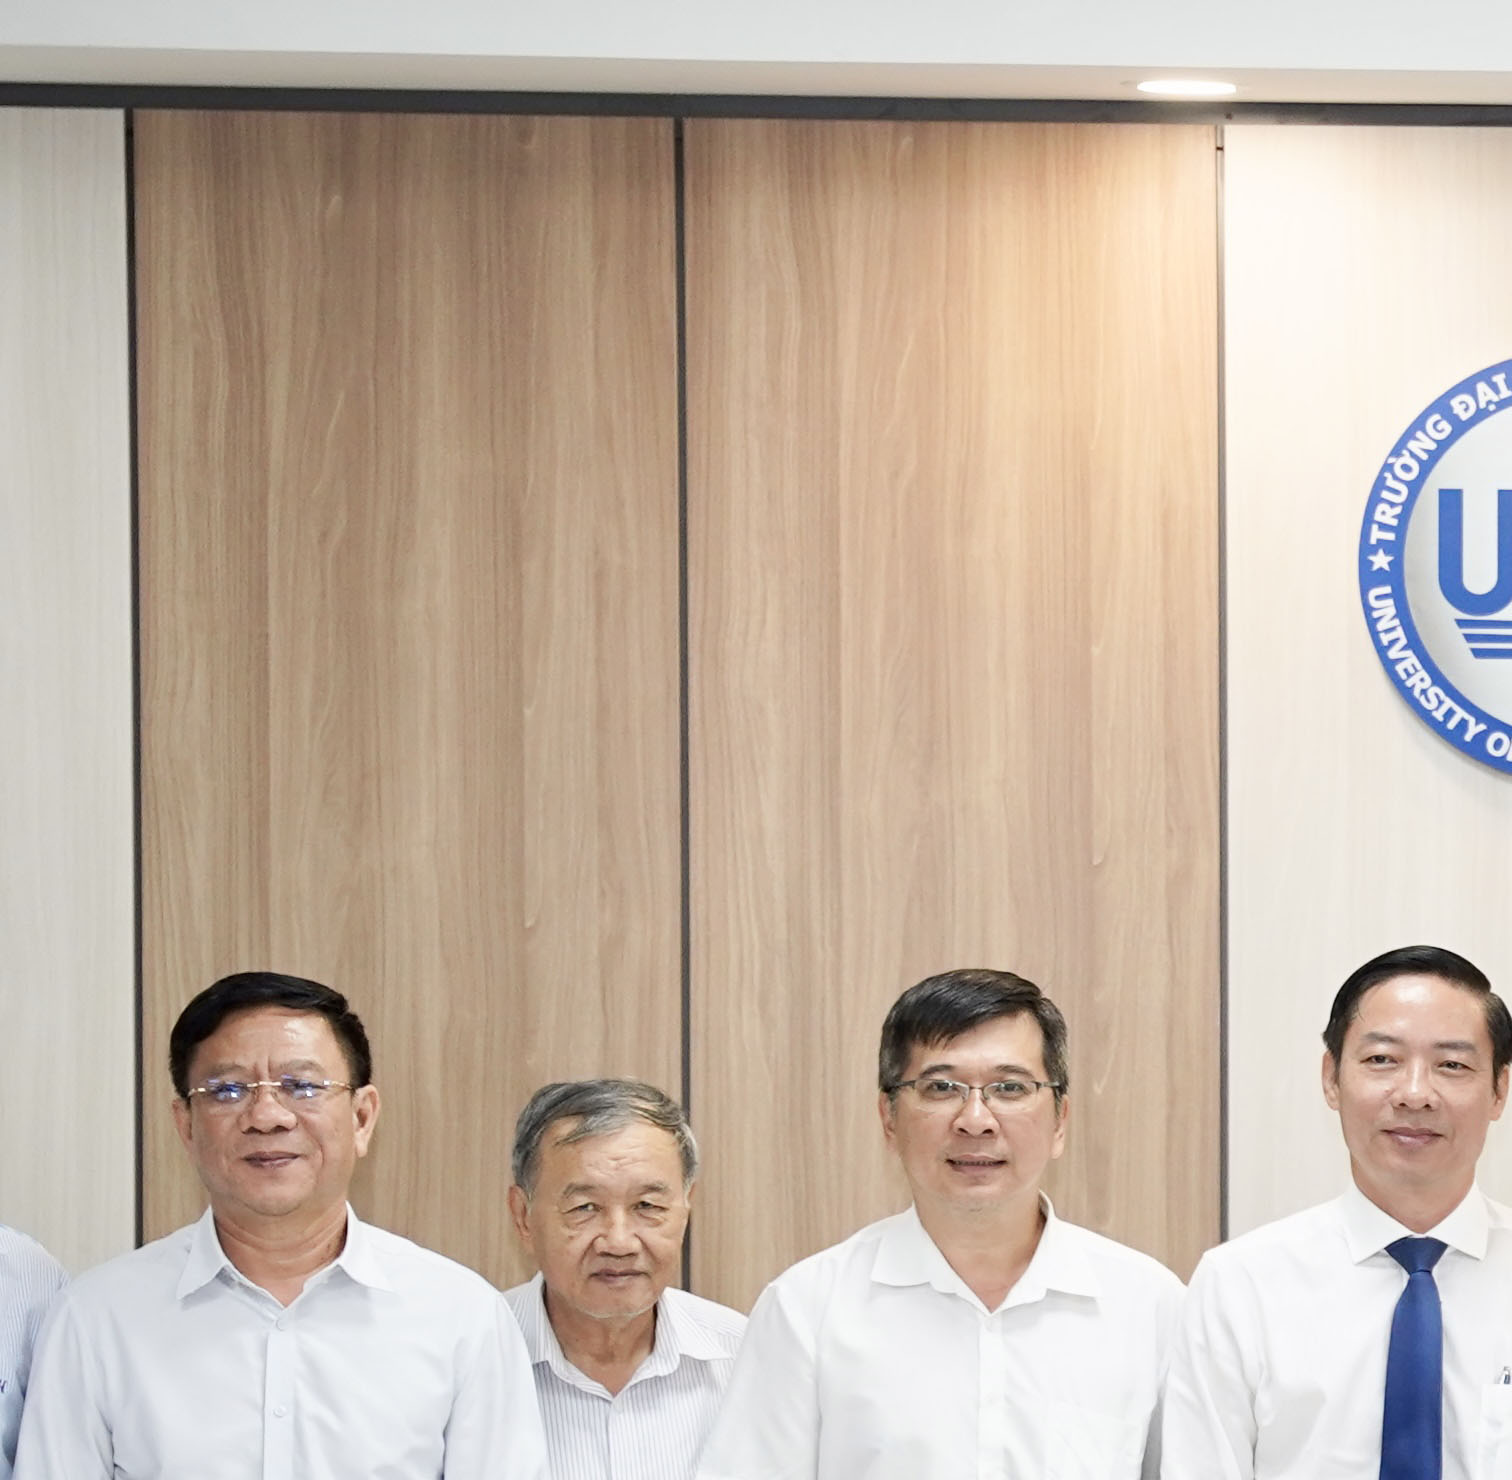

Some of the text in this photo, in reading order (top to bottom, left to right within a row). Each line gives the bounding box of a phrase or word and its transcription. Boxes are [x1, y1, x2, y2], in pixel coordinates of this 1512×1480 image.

[1370, 413, 1453, 545] TRƯỜNG
[1450, 372, 1512, 421] ĐẠI
[1368, 584, 1486, 742] UNIVERSITY
